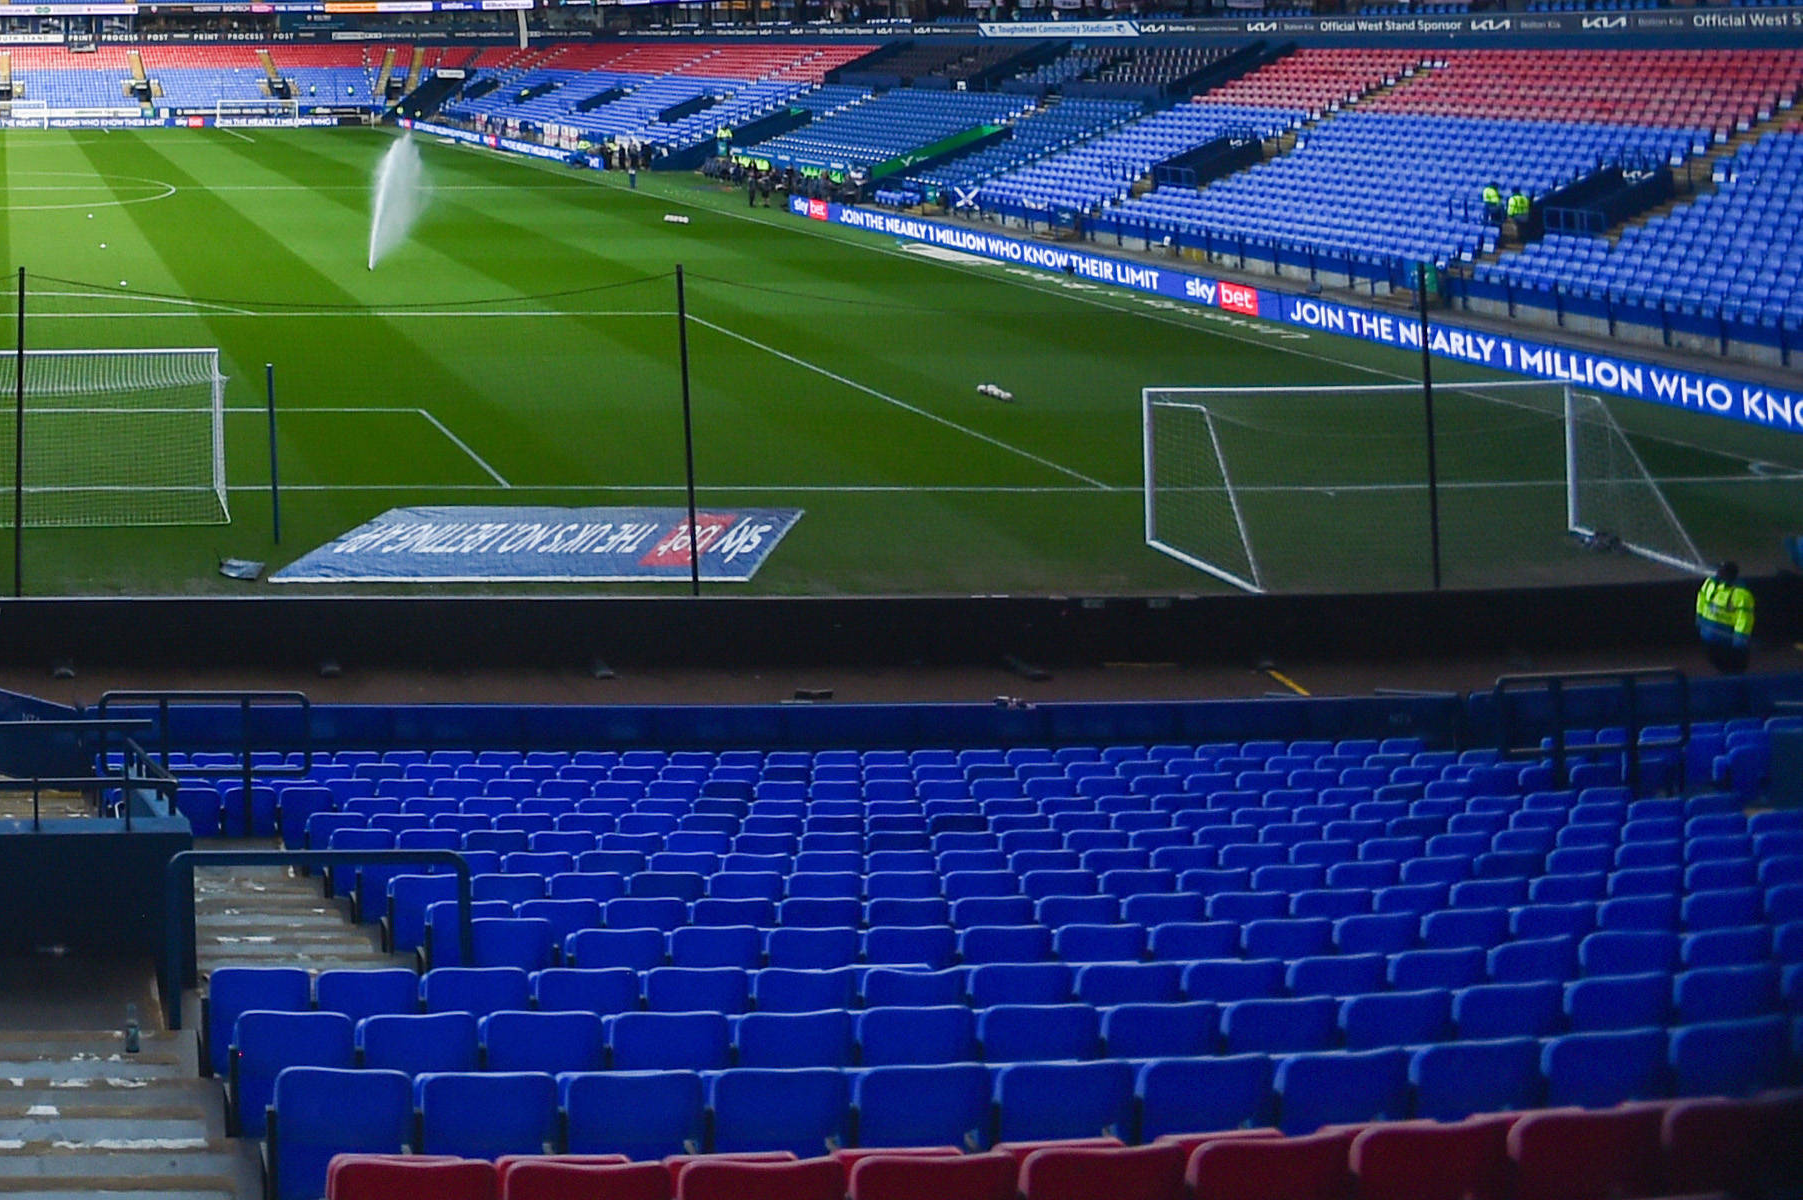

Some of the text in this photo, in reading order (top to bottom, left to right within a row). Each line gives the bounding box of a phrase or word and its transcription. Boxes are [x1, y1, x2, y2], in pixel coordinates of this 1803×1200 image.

[1319, 20, 1462, 34] Official West Stand Sponsor
[1692, 13, 1781, 28] Official West
[68, 33, 168, 41] PRINT PROCESS POST
[193, 33, 218, 41] PRINT
[227, 33, 264, 41] PROCESS
[997, 23, 1115, 36] Toughsheet Community Stadium
[793, 198, 825, 217] sky bet
[839, 209, 864, 227] JOIN
[864, 213, 884, 231] THE
[885, 217, 927, 242] NEARLY
[935, 228, 986, 253] MILLION
[987, 239, 1022, 260] WHO
[1022, 244, 1070, 270] KNOW
[1069, 253, 1114, 281] THEIR
[1115, 264, 1161, 290] LIMIT
[1184, 277, 1254, 310] sky bet
[1290, 298, 1345, 330] JOIN
[1347, 311, 1394, 341] THE
[1398, 321, 1496, 363] NEARLY
[1500, 341, 1513, 367] 1
[1519, 345, 1644, 395] MILLION
[1648, 370, 1734, 410] WHO
